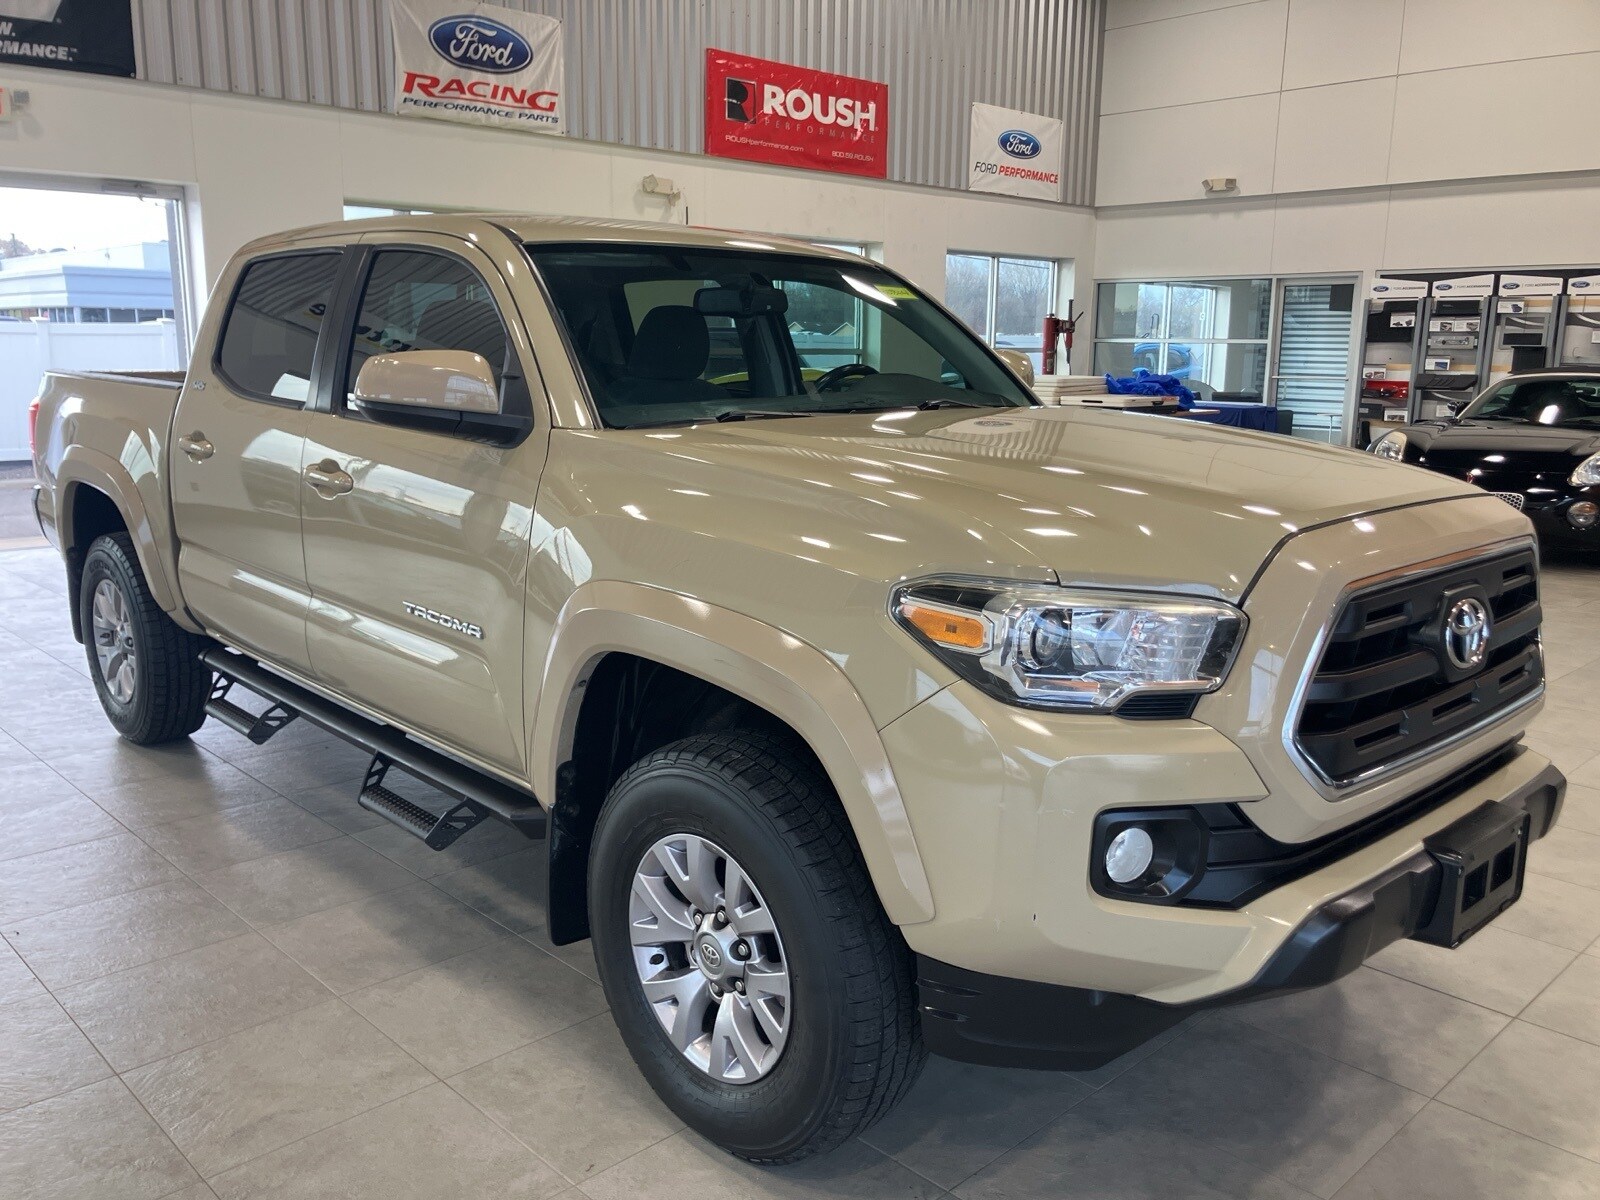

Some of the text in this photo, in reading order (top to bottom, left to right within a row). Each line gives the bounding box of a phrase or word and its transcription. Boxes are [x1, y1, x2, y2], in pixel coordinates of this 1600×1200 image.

[0, 40, 73, 62] MANCE.
[450, 23, 514, 67] Ford
[403, 71, 559, 112] RACING
[403, 97, 559, 124] PERFORMANCE PARTS
[763, 84, 877, 131] ROUSH
[764, 119, 875, 144] PERFORMANCE
[1006, 134, 1034, 155] Ford
[974, 161, 1058, 184] FORD PERFORMANCE
[402, 601, 484, 639] TACOMA
